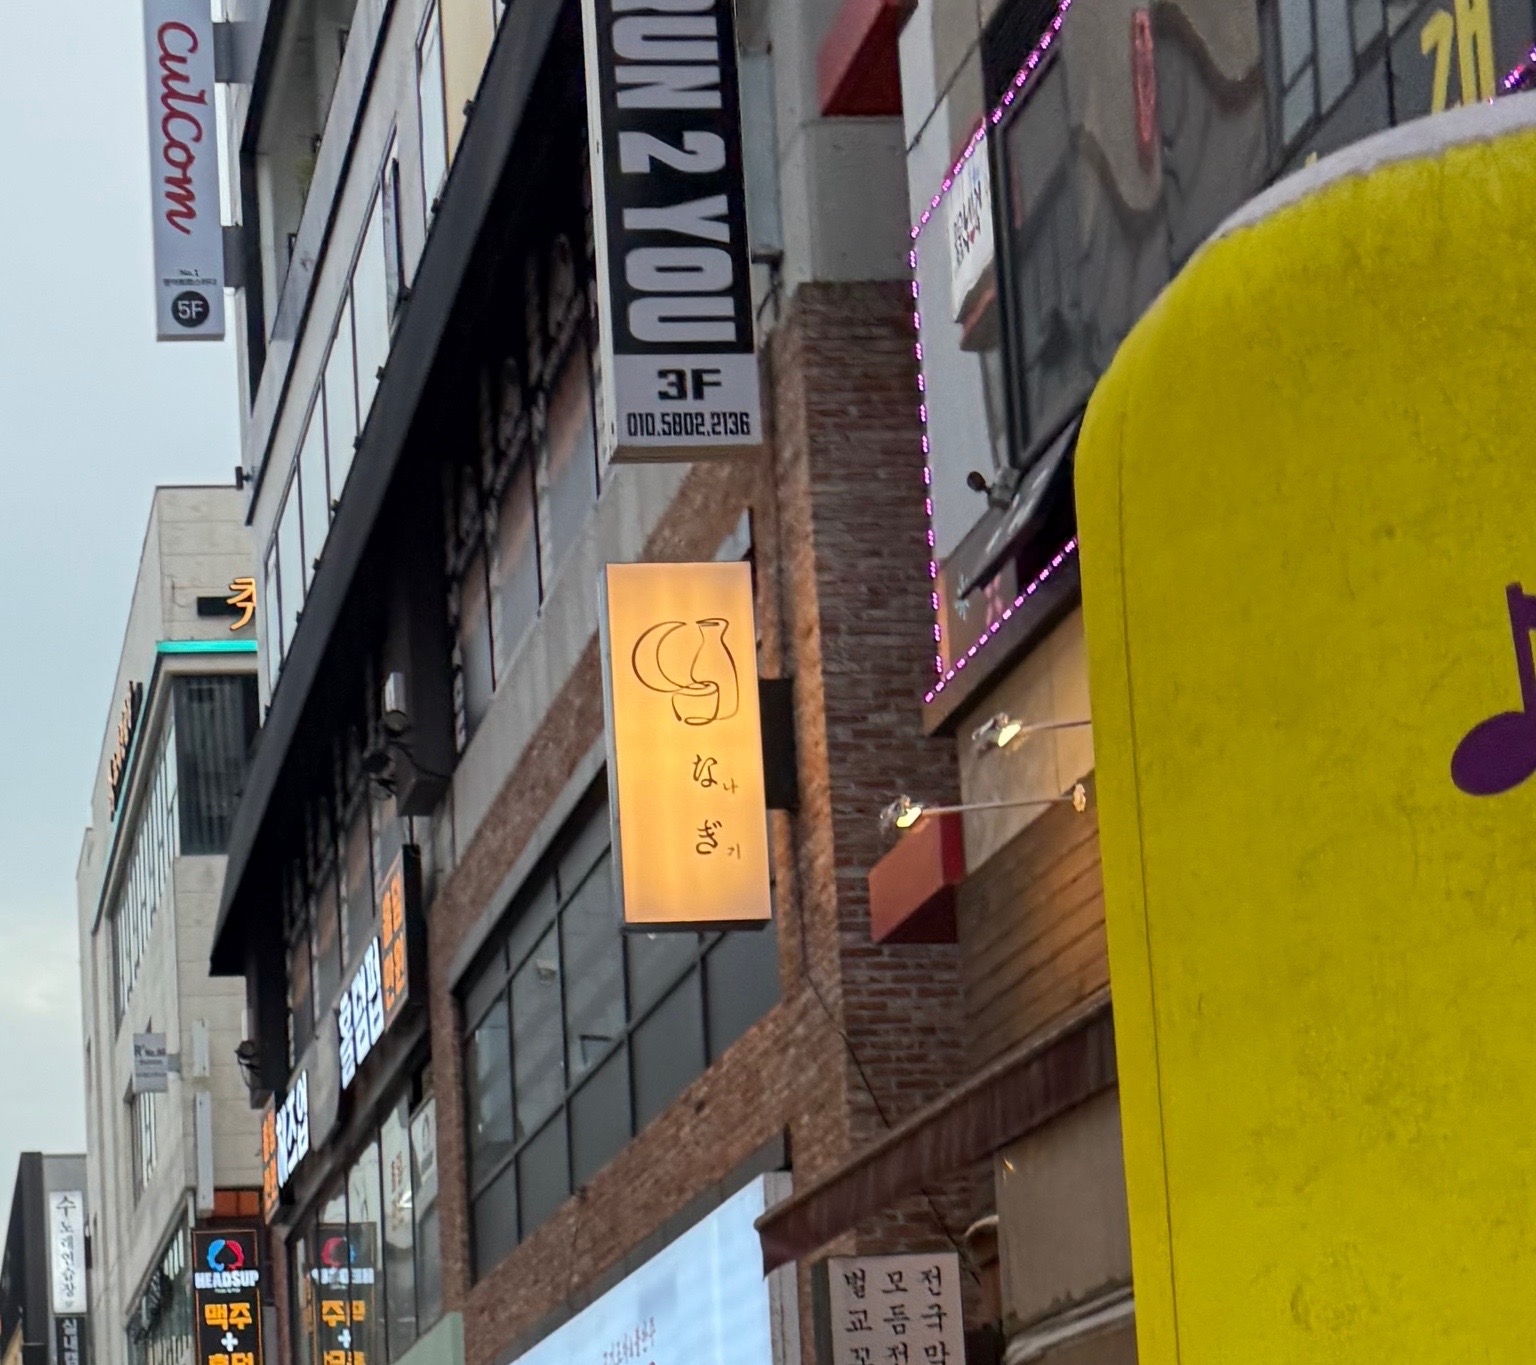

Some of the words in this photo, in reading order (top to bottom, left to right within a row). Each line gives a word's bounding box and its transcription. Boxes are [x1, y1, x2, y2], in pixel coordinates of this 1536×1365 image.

[619, 131, 726, 174] 2
[621, 200, 737, 343] YOU
[177, 300, 204, 319] 5F
[657, 369, 722, 400] 3F
[627, 411, 751, 438] 010.5802.2136
[195, 1269, 260, 1289] HEADSUP
[204, 1301, 253, 1331] 맥주
